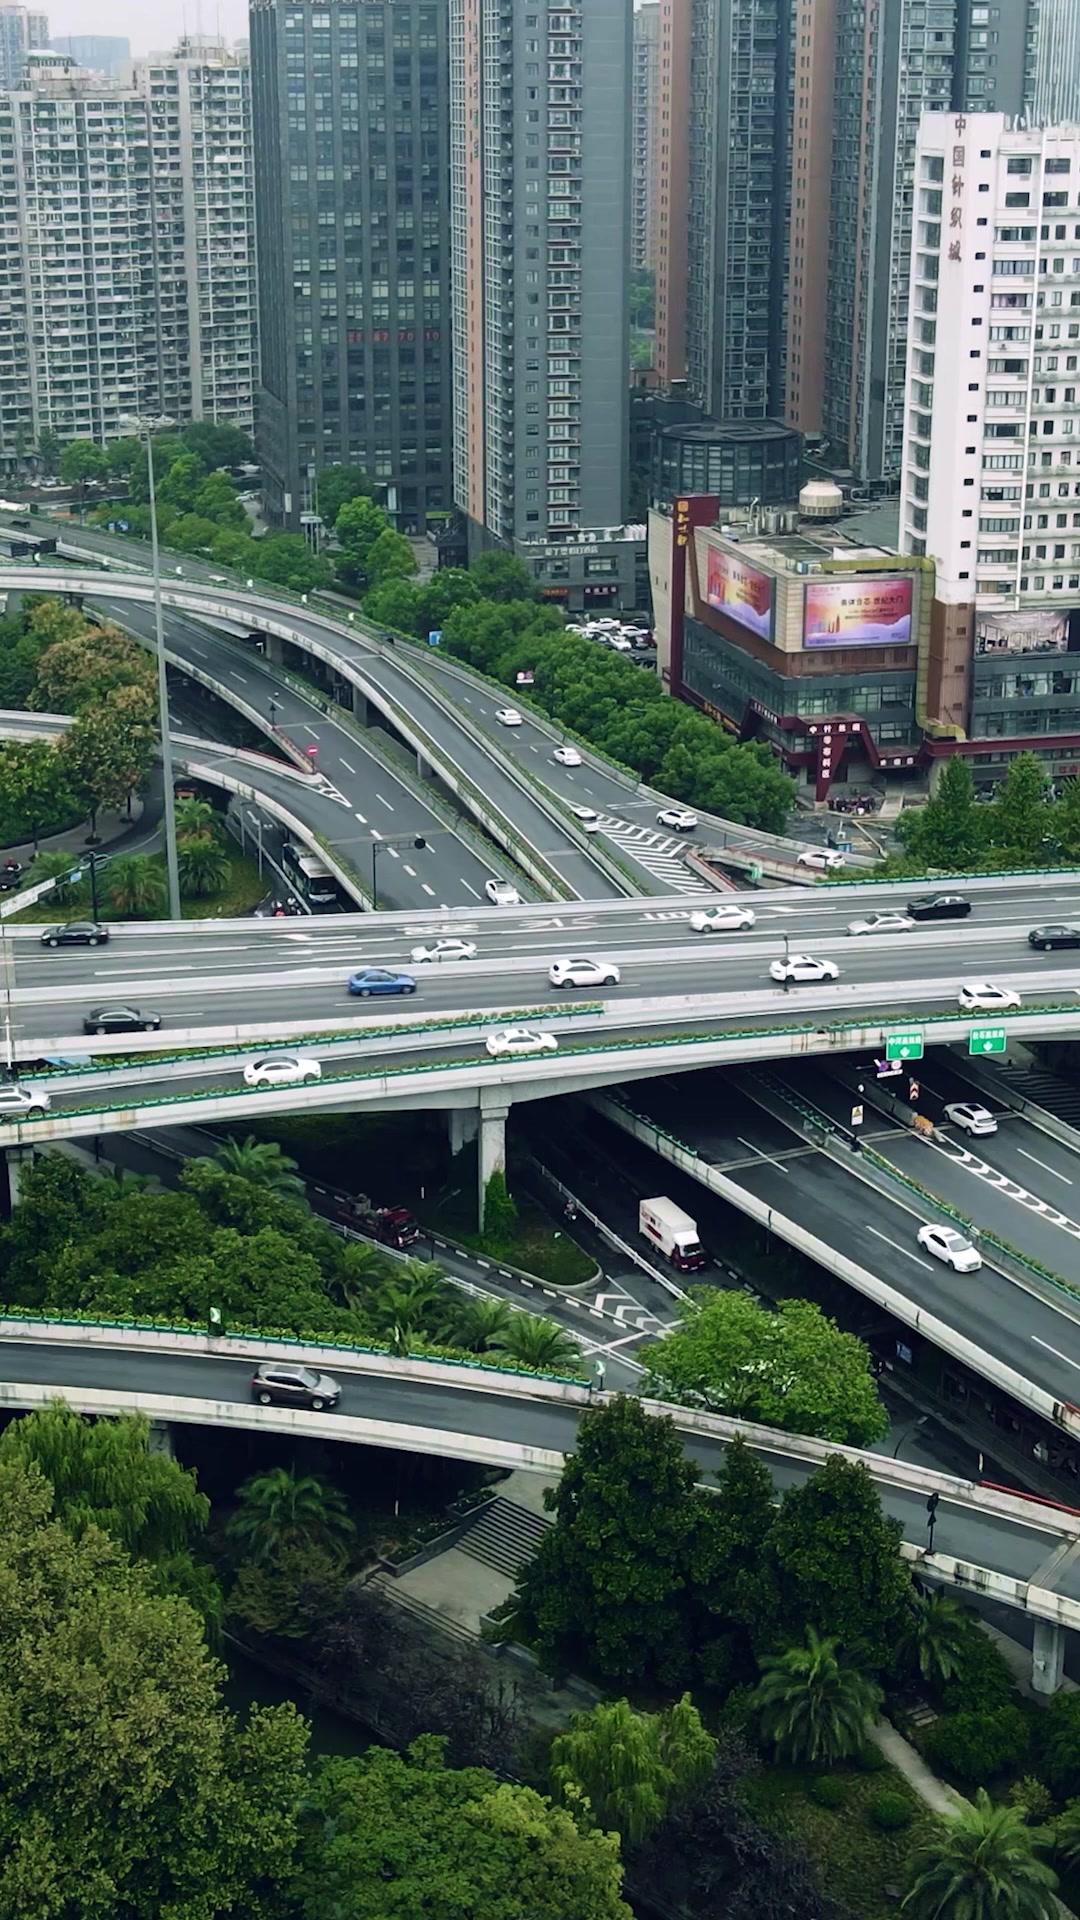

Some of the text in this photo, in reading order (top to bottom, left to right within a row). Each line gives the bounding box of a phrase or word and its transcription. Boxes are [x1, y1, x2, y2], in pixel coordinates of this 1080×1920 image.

[948, 114, 967, 263] 中国针织城
[888, 1035, 921, 1046] 中河高架路
